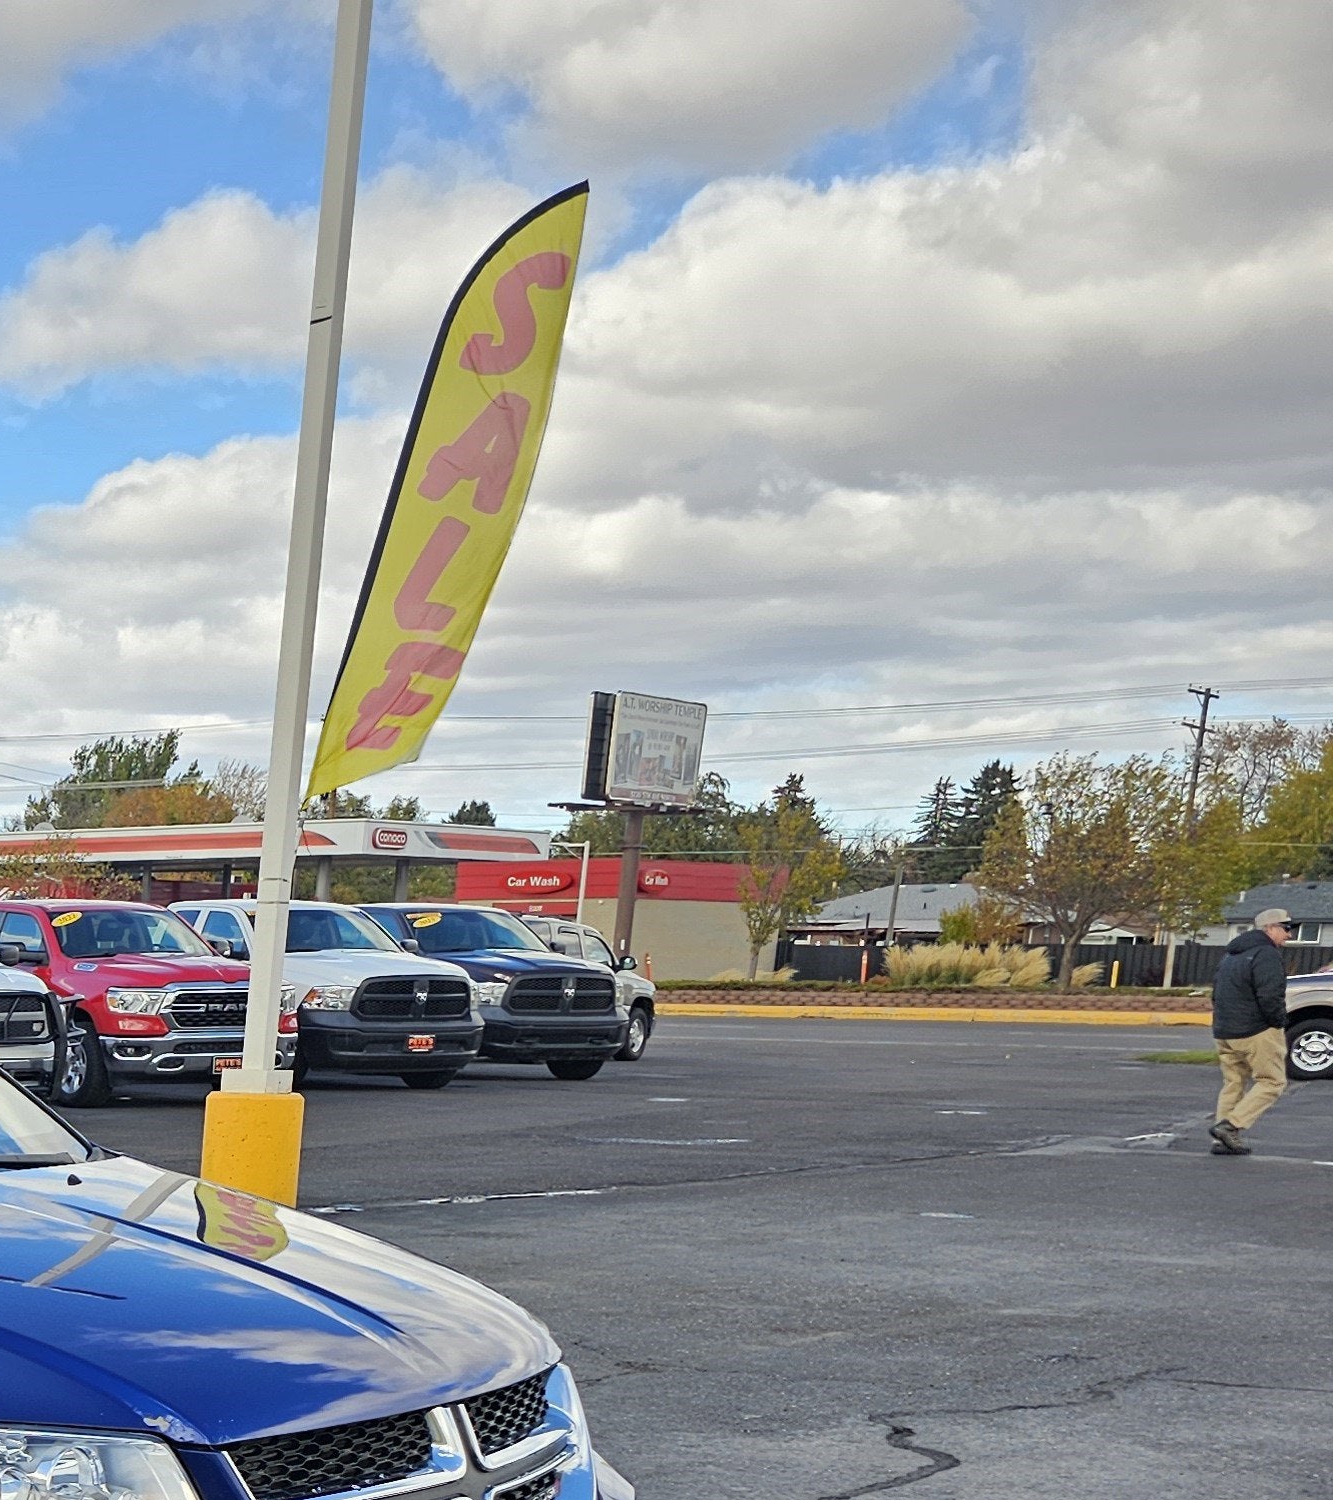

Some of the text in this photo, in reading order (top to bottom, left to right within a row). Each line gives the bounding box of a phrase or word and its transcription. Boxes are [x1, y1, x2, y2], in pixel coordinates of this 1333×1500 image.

[345, 251, 571, 751] SALE
[638, 699, 674, 715] WORSHIP
[675, 704, 703, 721] TEMPLE
[507, 875, 561, 887] Car Wash
[644, 875, 669, 886] Car Wash
